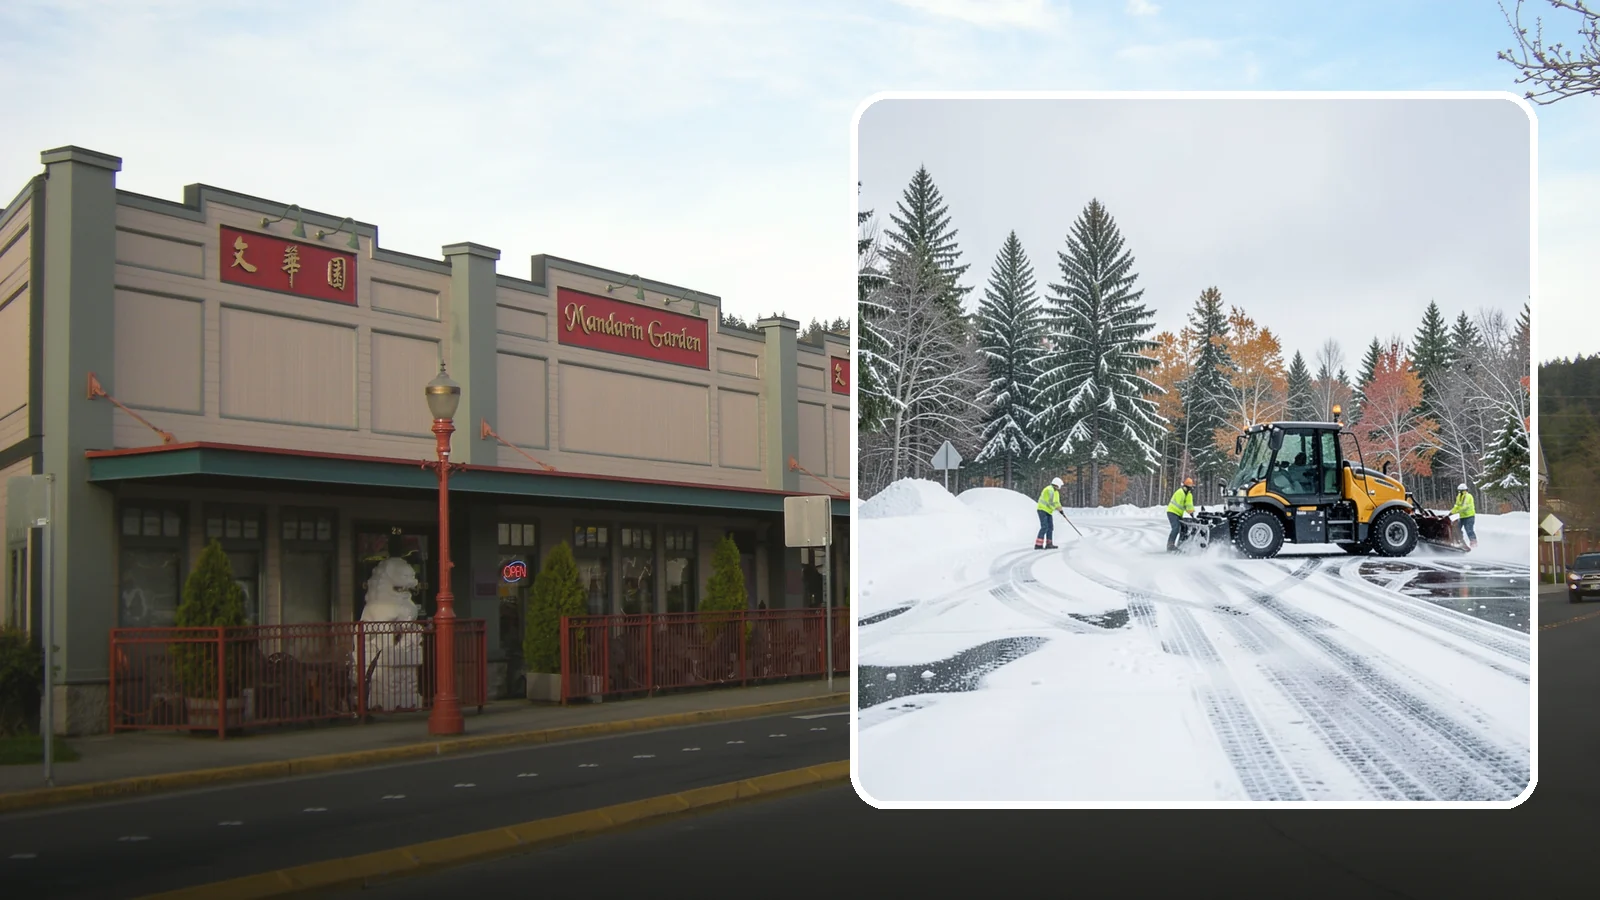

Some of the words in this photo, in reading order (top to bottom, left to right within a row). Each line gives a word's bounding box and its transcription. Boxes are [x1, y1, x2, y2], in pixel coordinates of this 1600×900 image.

[231, 235, 346, 291] 文華園
[564, 302, 644, 341] Mandarin
[648, 320, 701, 352] Garden
[503, 565, 527, 578] OPEN
